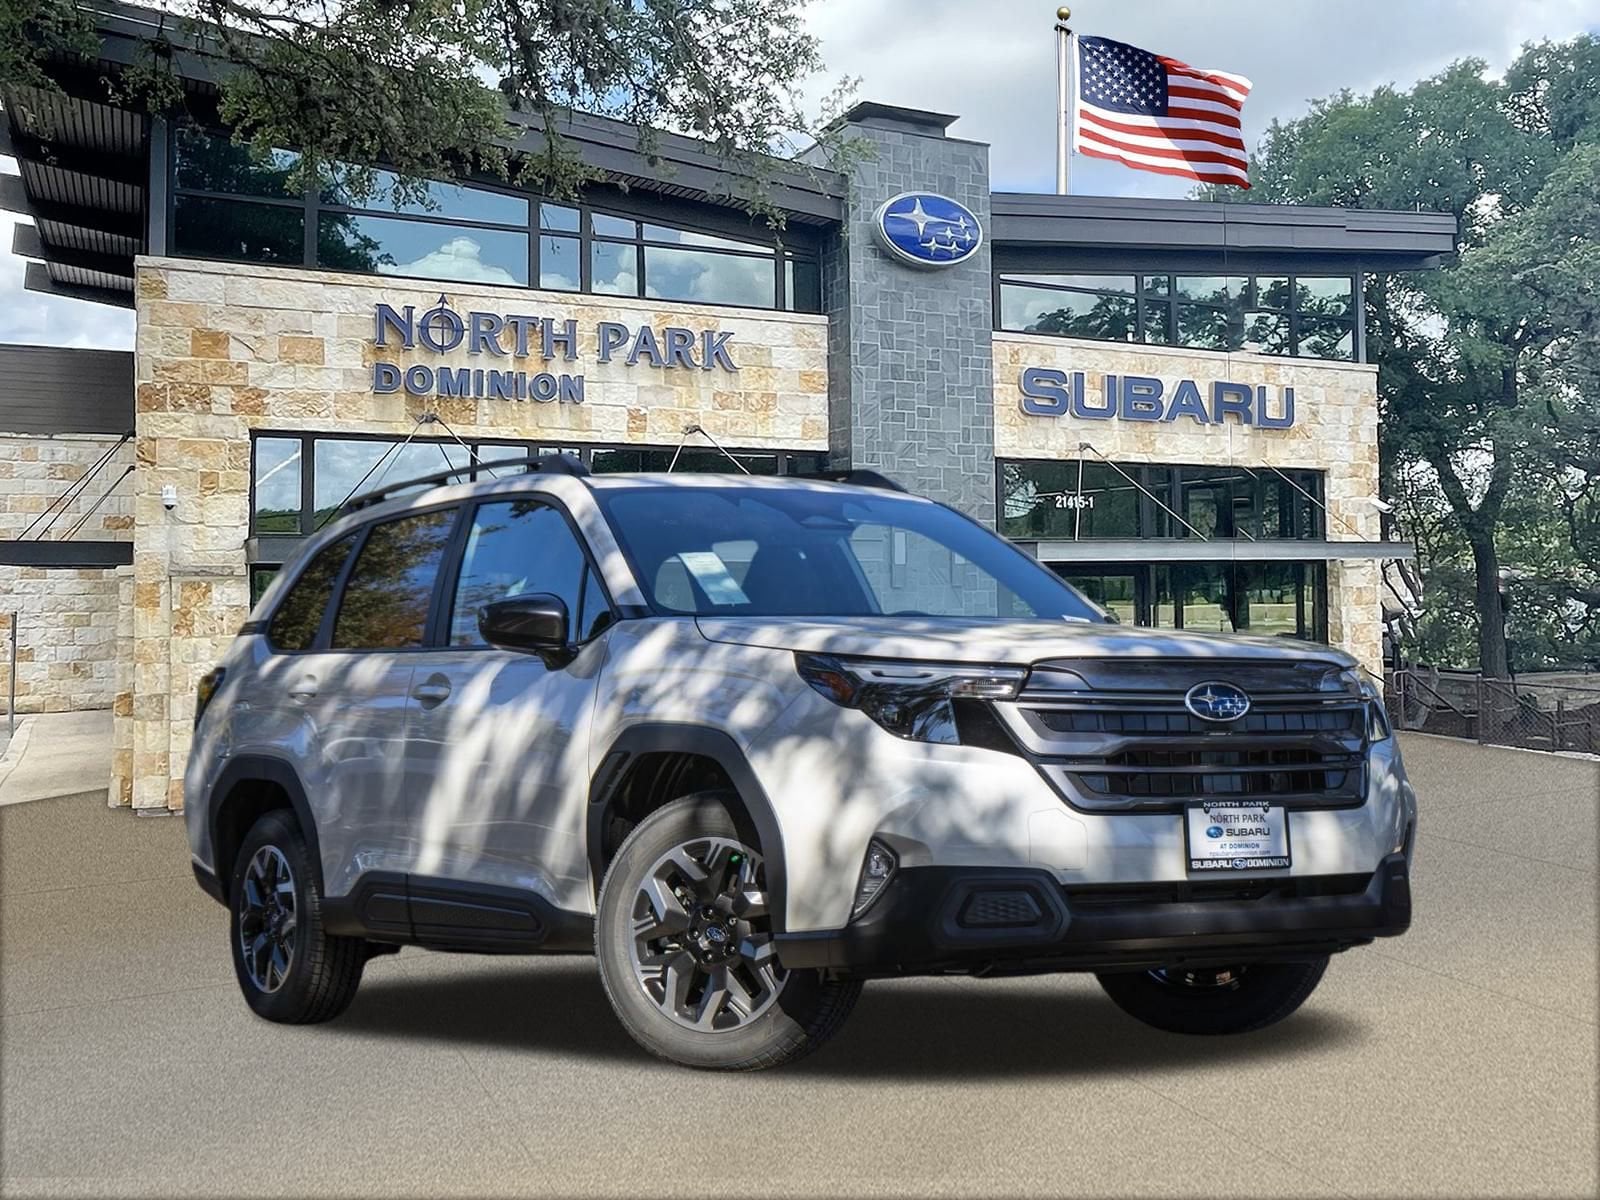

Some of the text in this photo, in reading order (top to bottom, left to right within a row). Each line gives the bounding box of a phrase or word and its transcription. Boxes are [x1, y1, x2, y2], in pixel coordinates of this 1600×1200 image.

[374, 300, 742, 372] NORTH PARK
[373, 362, 585, 404] DOMINION
[1019, 367, 1295, 429] SUBARU
[1055, 495, 1094, 509] 21415-1
[1209, 813, 1267, 823] NORTH PARK
[1225, 827, 1271, 837] SUBARU
[1192, 858, 1289, 869] SUBARU DOMINION
